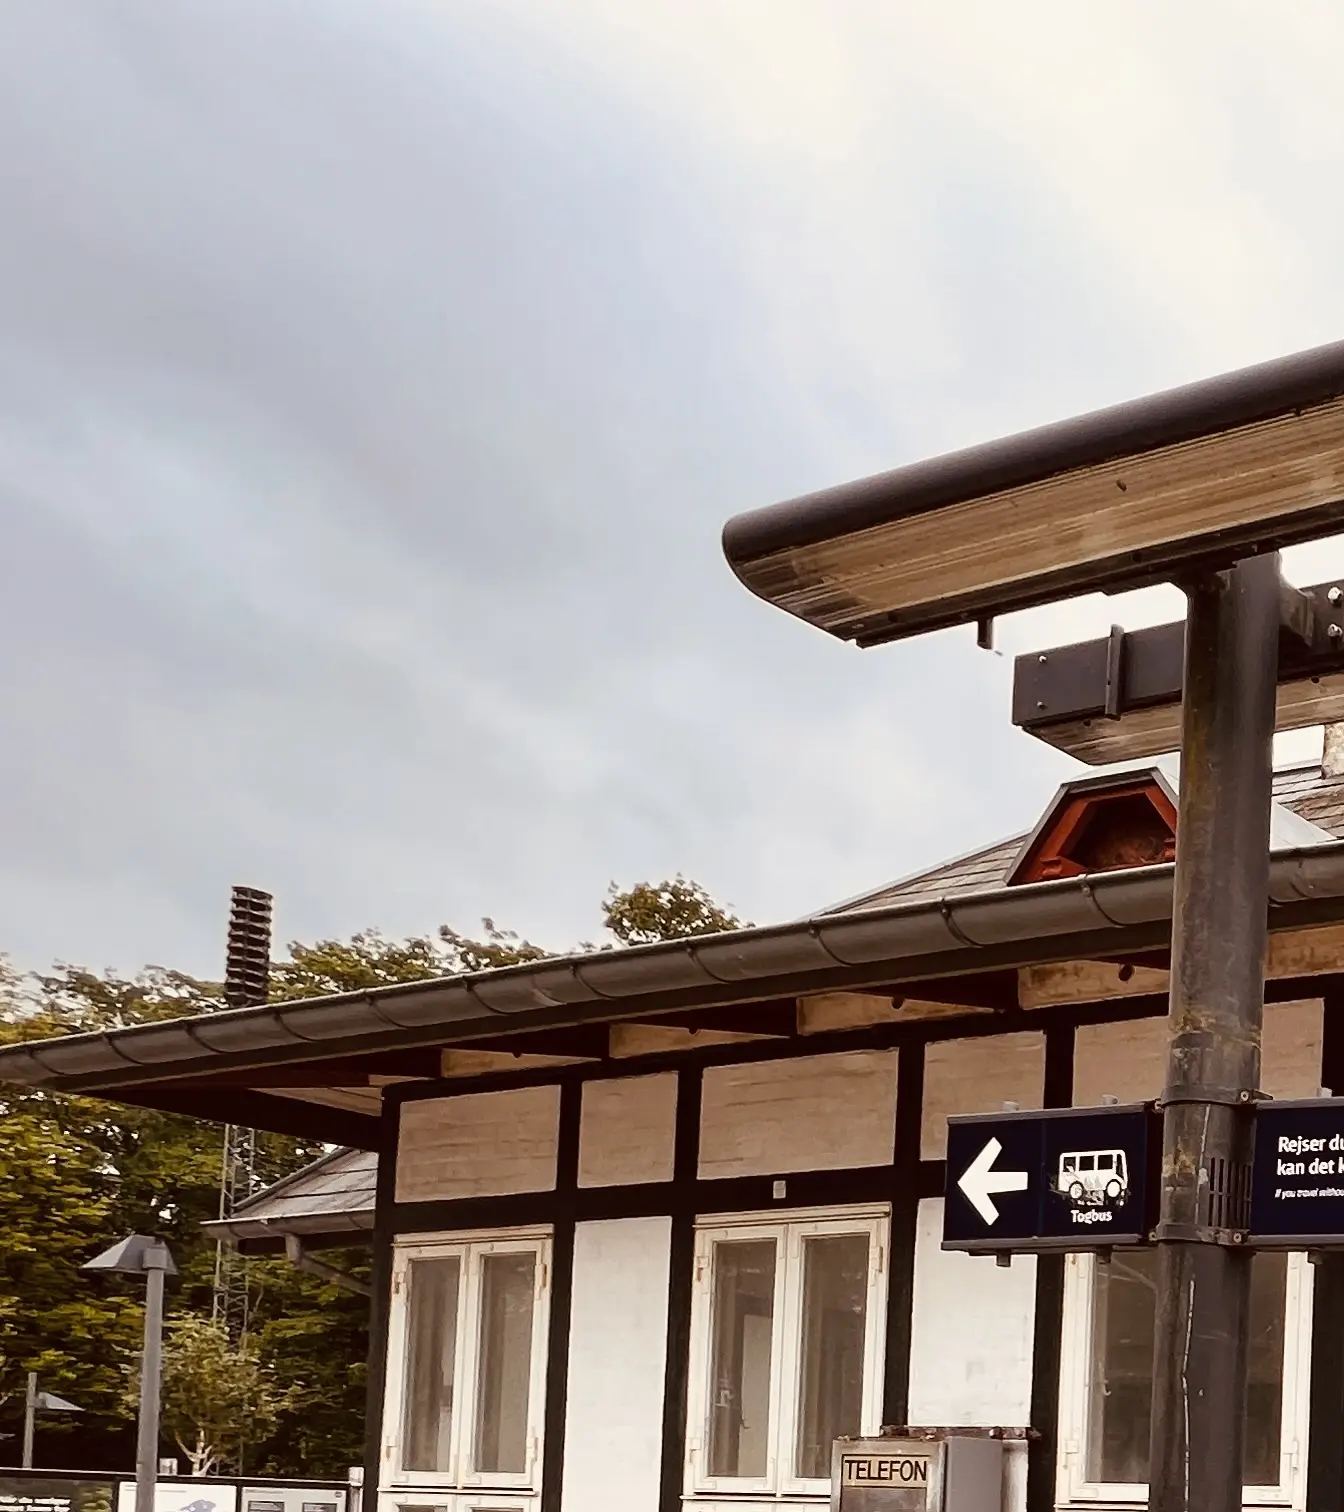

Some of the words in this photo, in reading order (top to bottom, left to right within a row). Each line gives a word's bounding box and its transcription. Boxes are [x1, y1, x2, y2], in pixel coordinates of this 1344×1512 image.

[1278, 1136, 1327, 1155] Rejser
[1276, 1158, 1305, 1175] kan
[1308, 1157, 1335, 1175] det
[1070, 1208, 1113, 1225] Togbus
[844, 1459, 927, 1482] TELEFON
